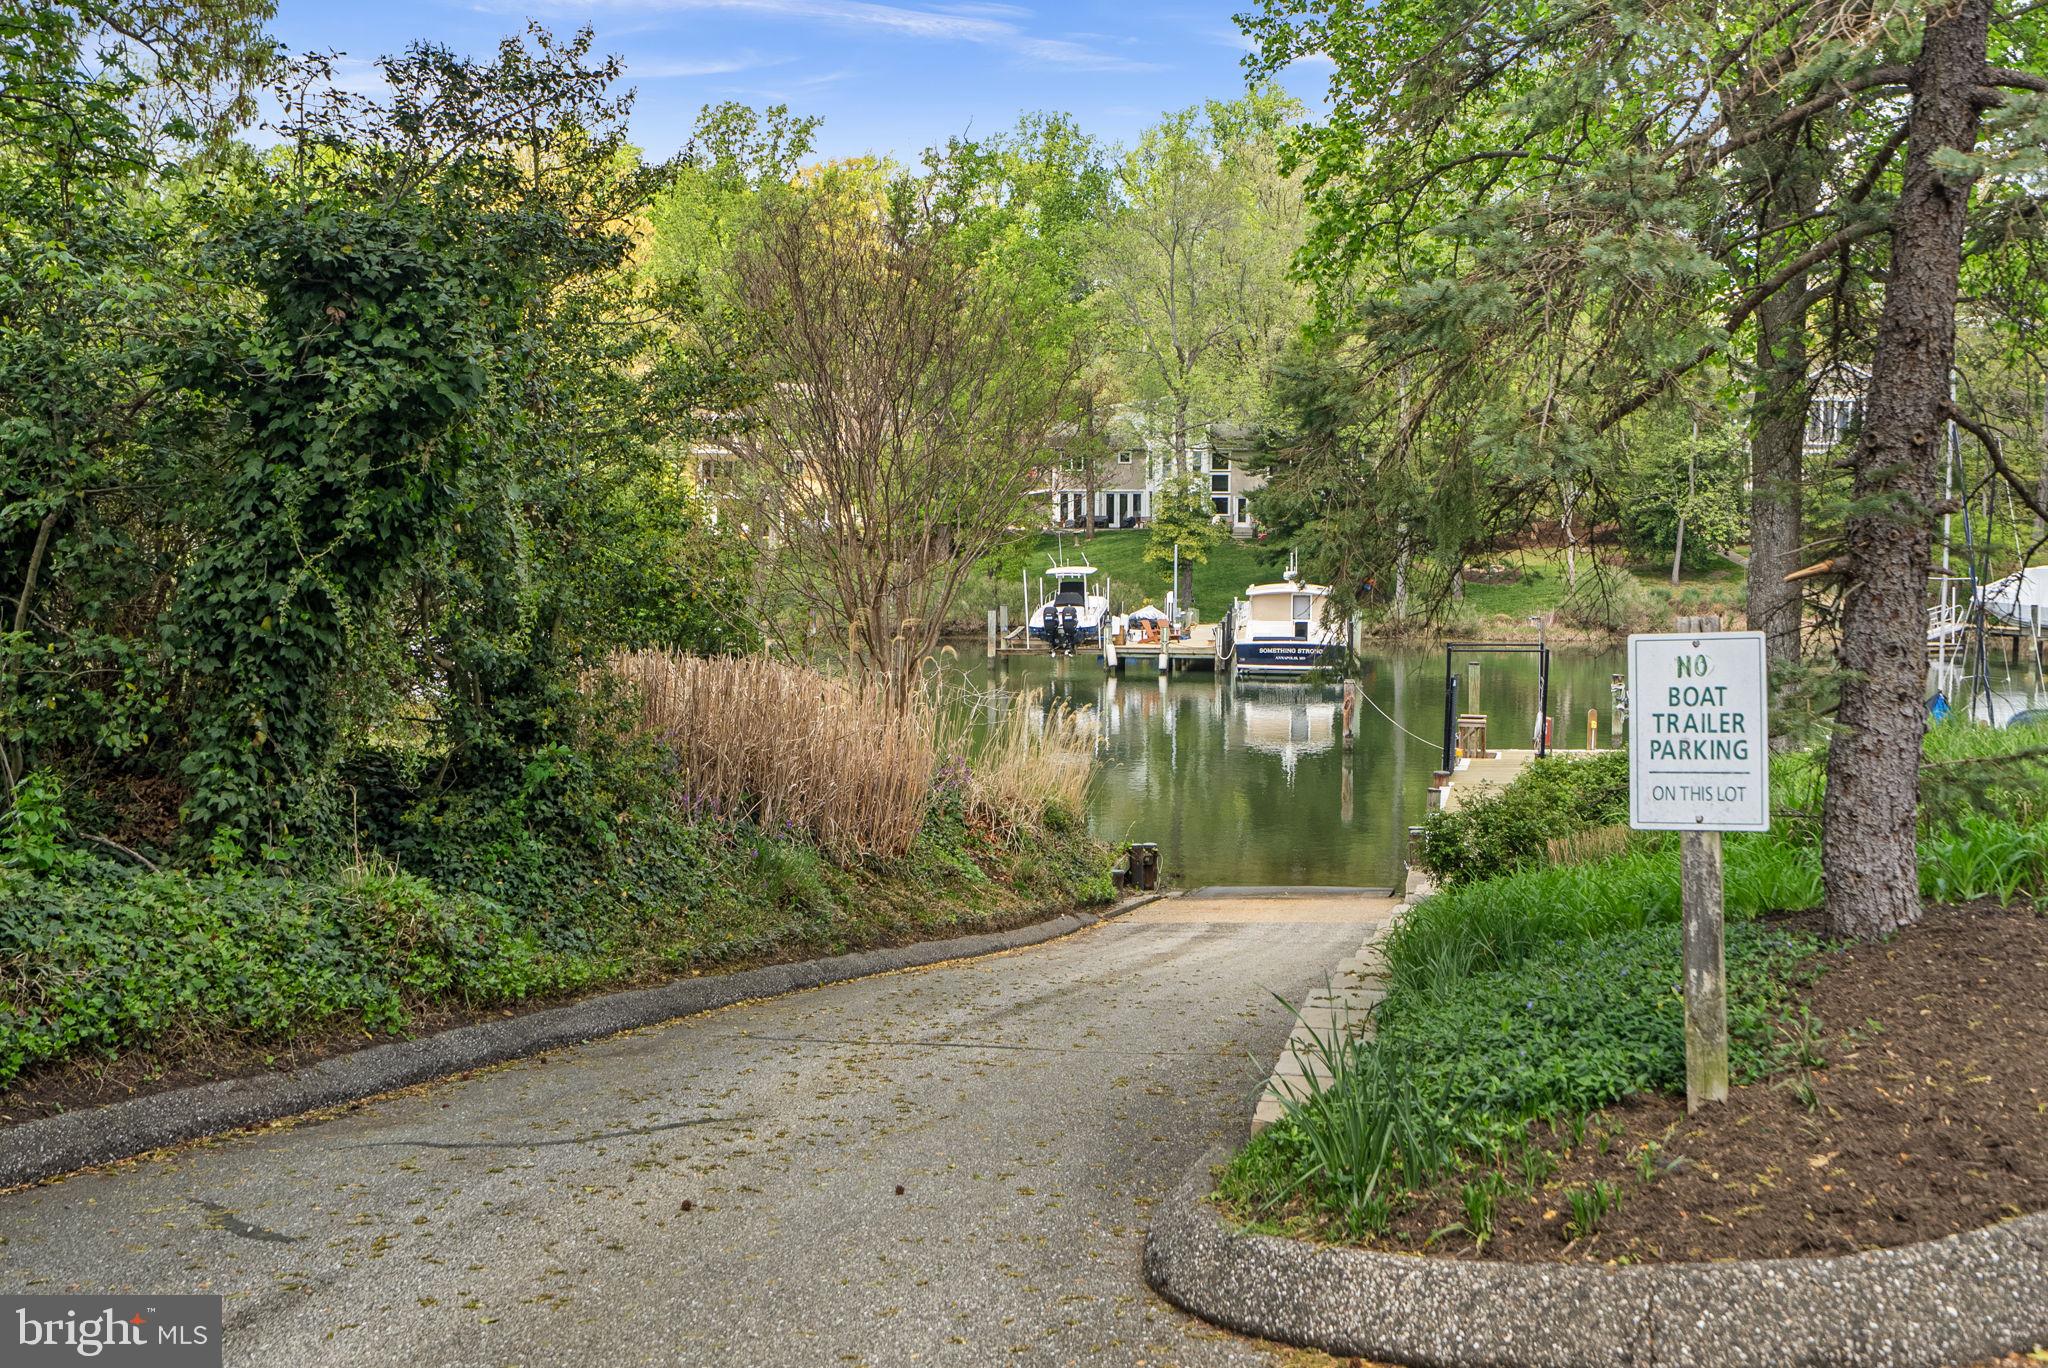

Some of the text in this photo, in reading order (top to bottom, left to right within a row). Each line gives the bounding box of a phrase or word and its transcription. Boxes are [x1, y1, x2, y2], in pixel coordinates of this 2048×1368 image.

[1676, 654, 1708, 678] NO
[1668, 686, 1727, 707] BOAT
[1652, 713, 1745, 734] TRAILER
[1650, 739, 1748, 760] PARKING
[1652, 785, 1746, 802] ON THIS LOT
